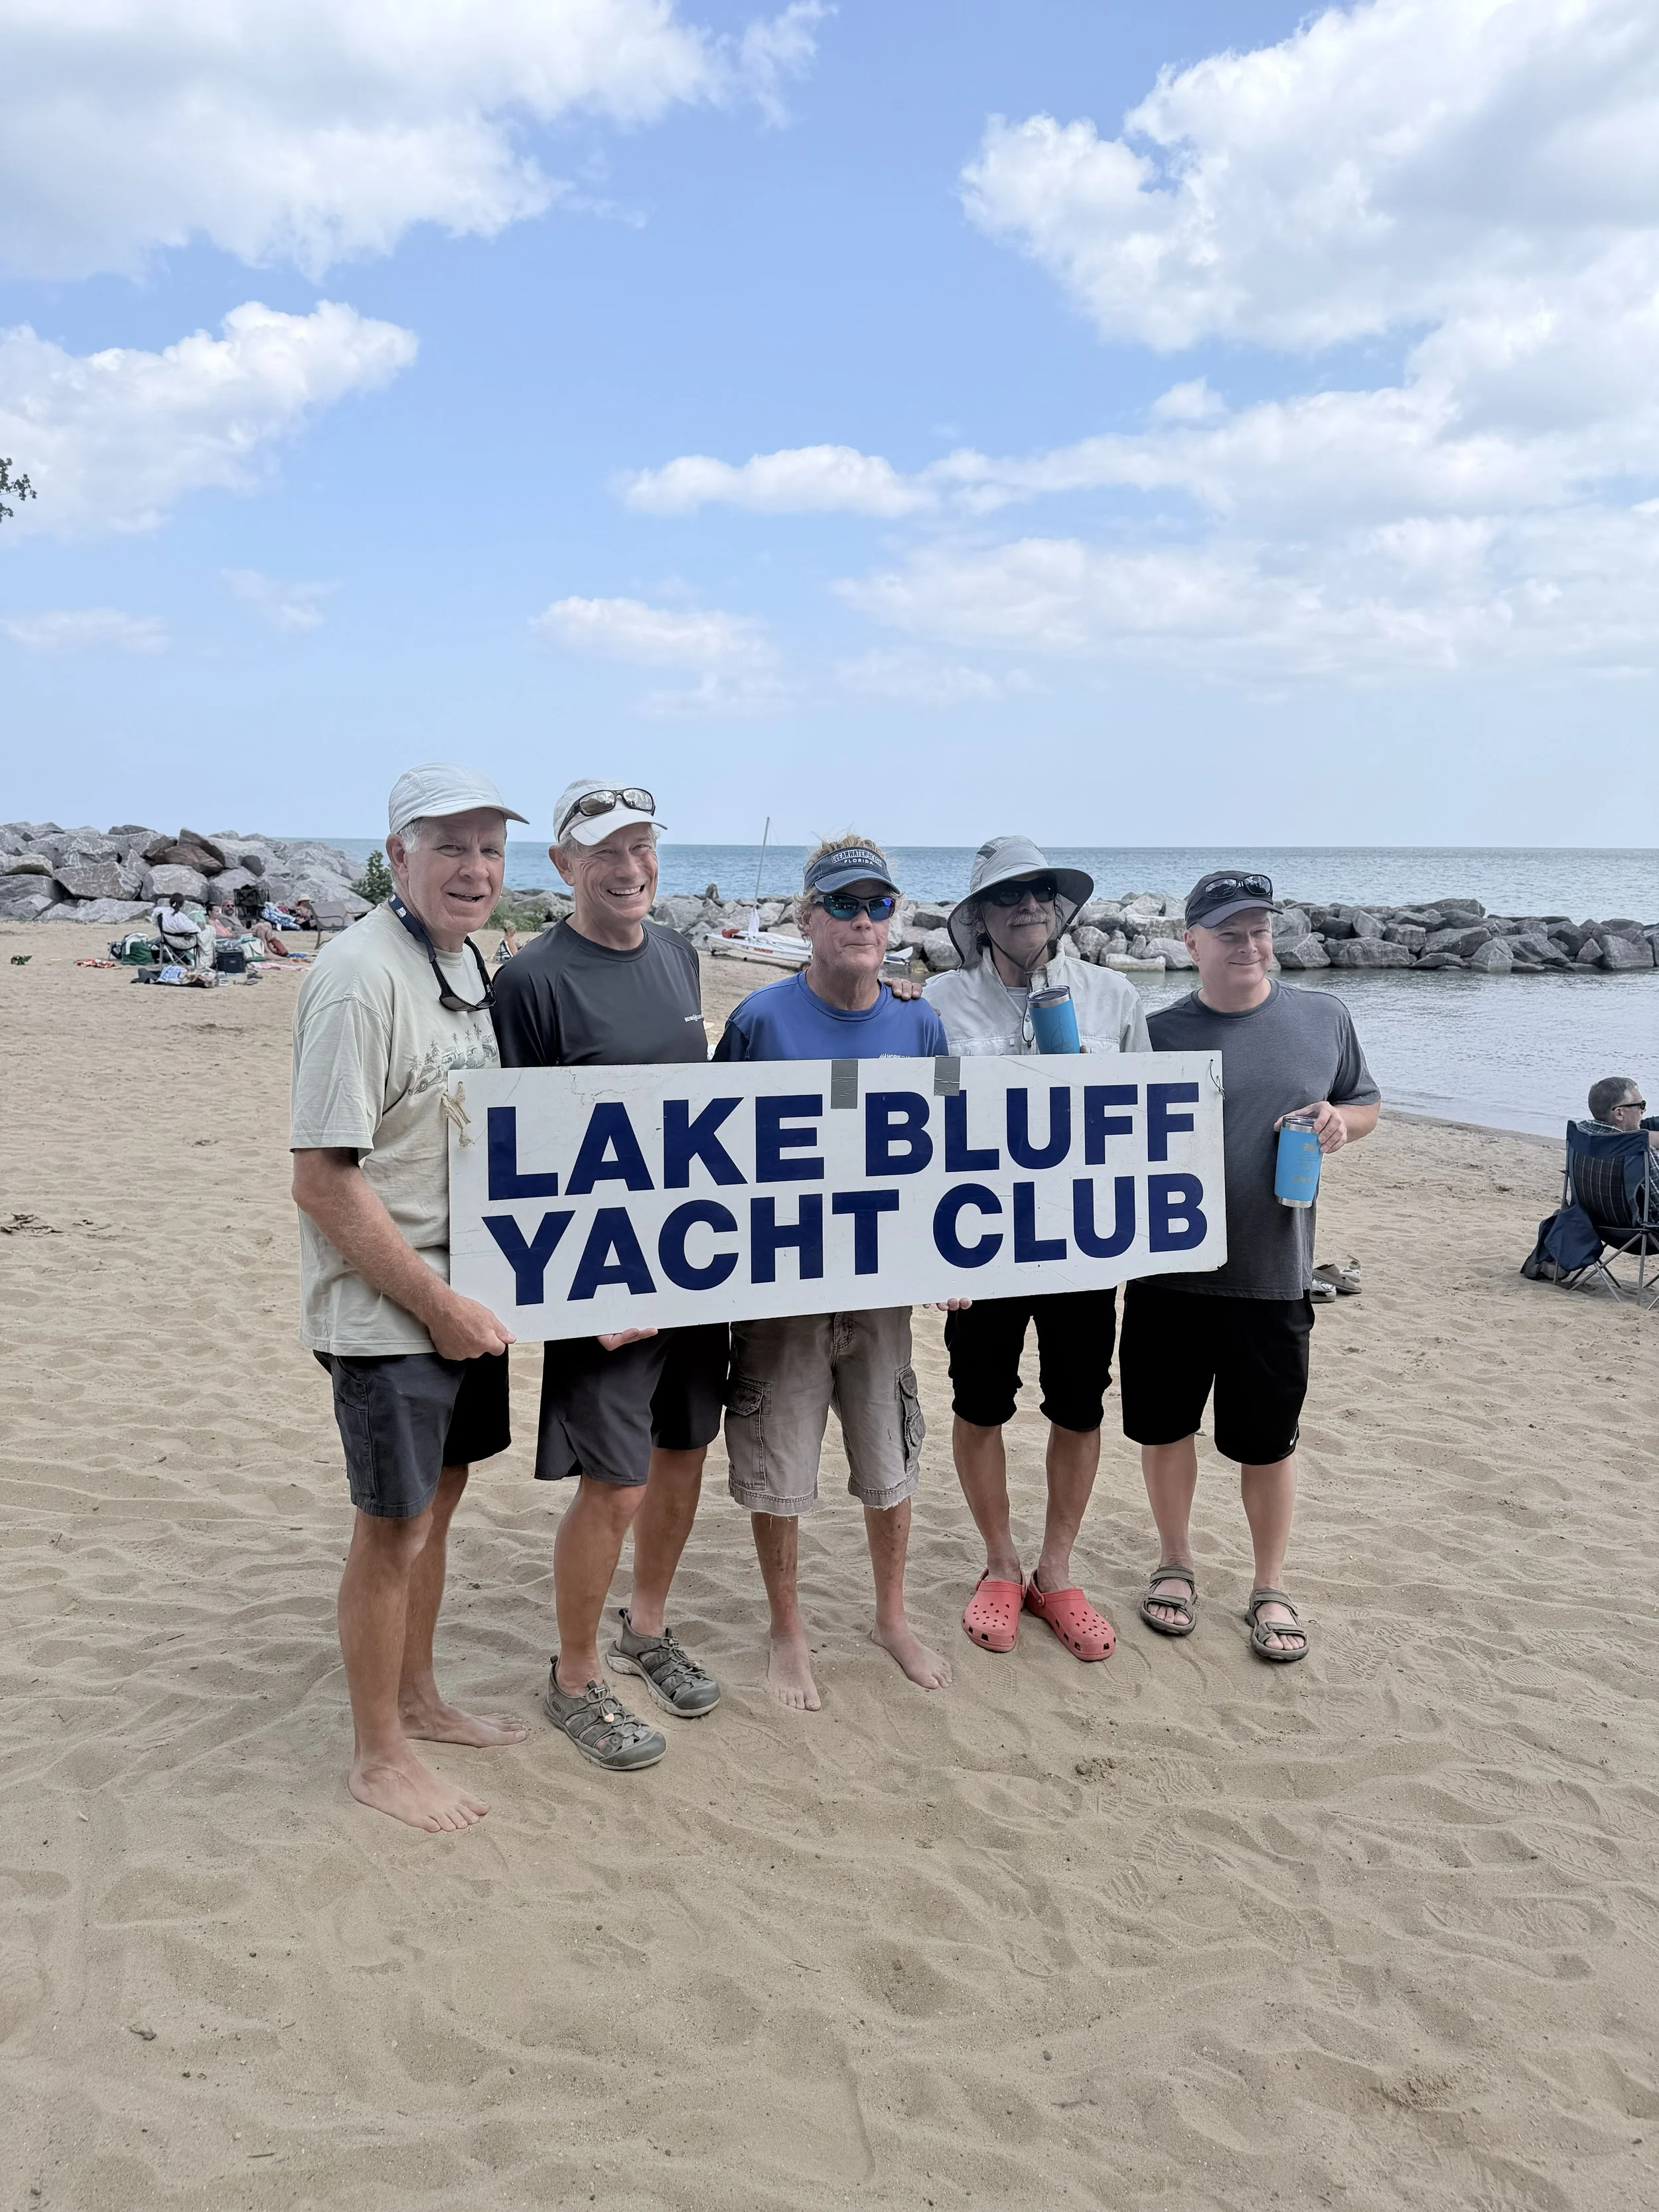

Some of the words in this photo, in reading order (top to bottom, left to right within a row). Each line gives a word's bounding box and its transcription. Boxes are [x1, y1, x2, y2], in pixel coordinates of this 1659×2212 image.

[831, 849, 867, 863] CLEARWATER
[488, 1094, 824, 1201] LAKE
[865, 1082, 1198, 1177] BLUFF
[481, 1189, 899, 1306] YACHT
[933, 1173, 1207, 1268] CLUB
